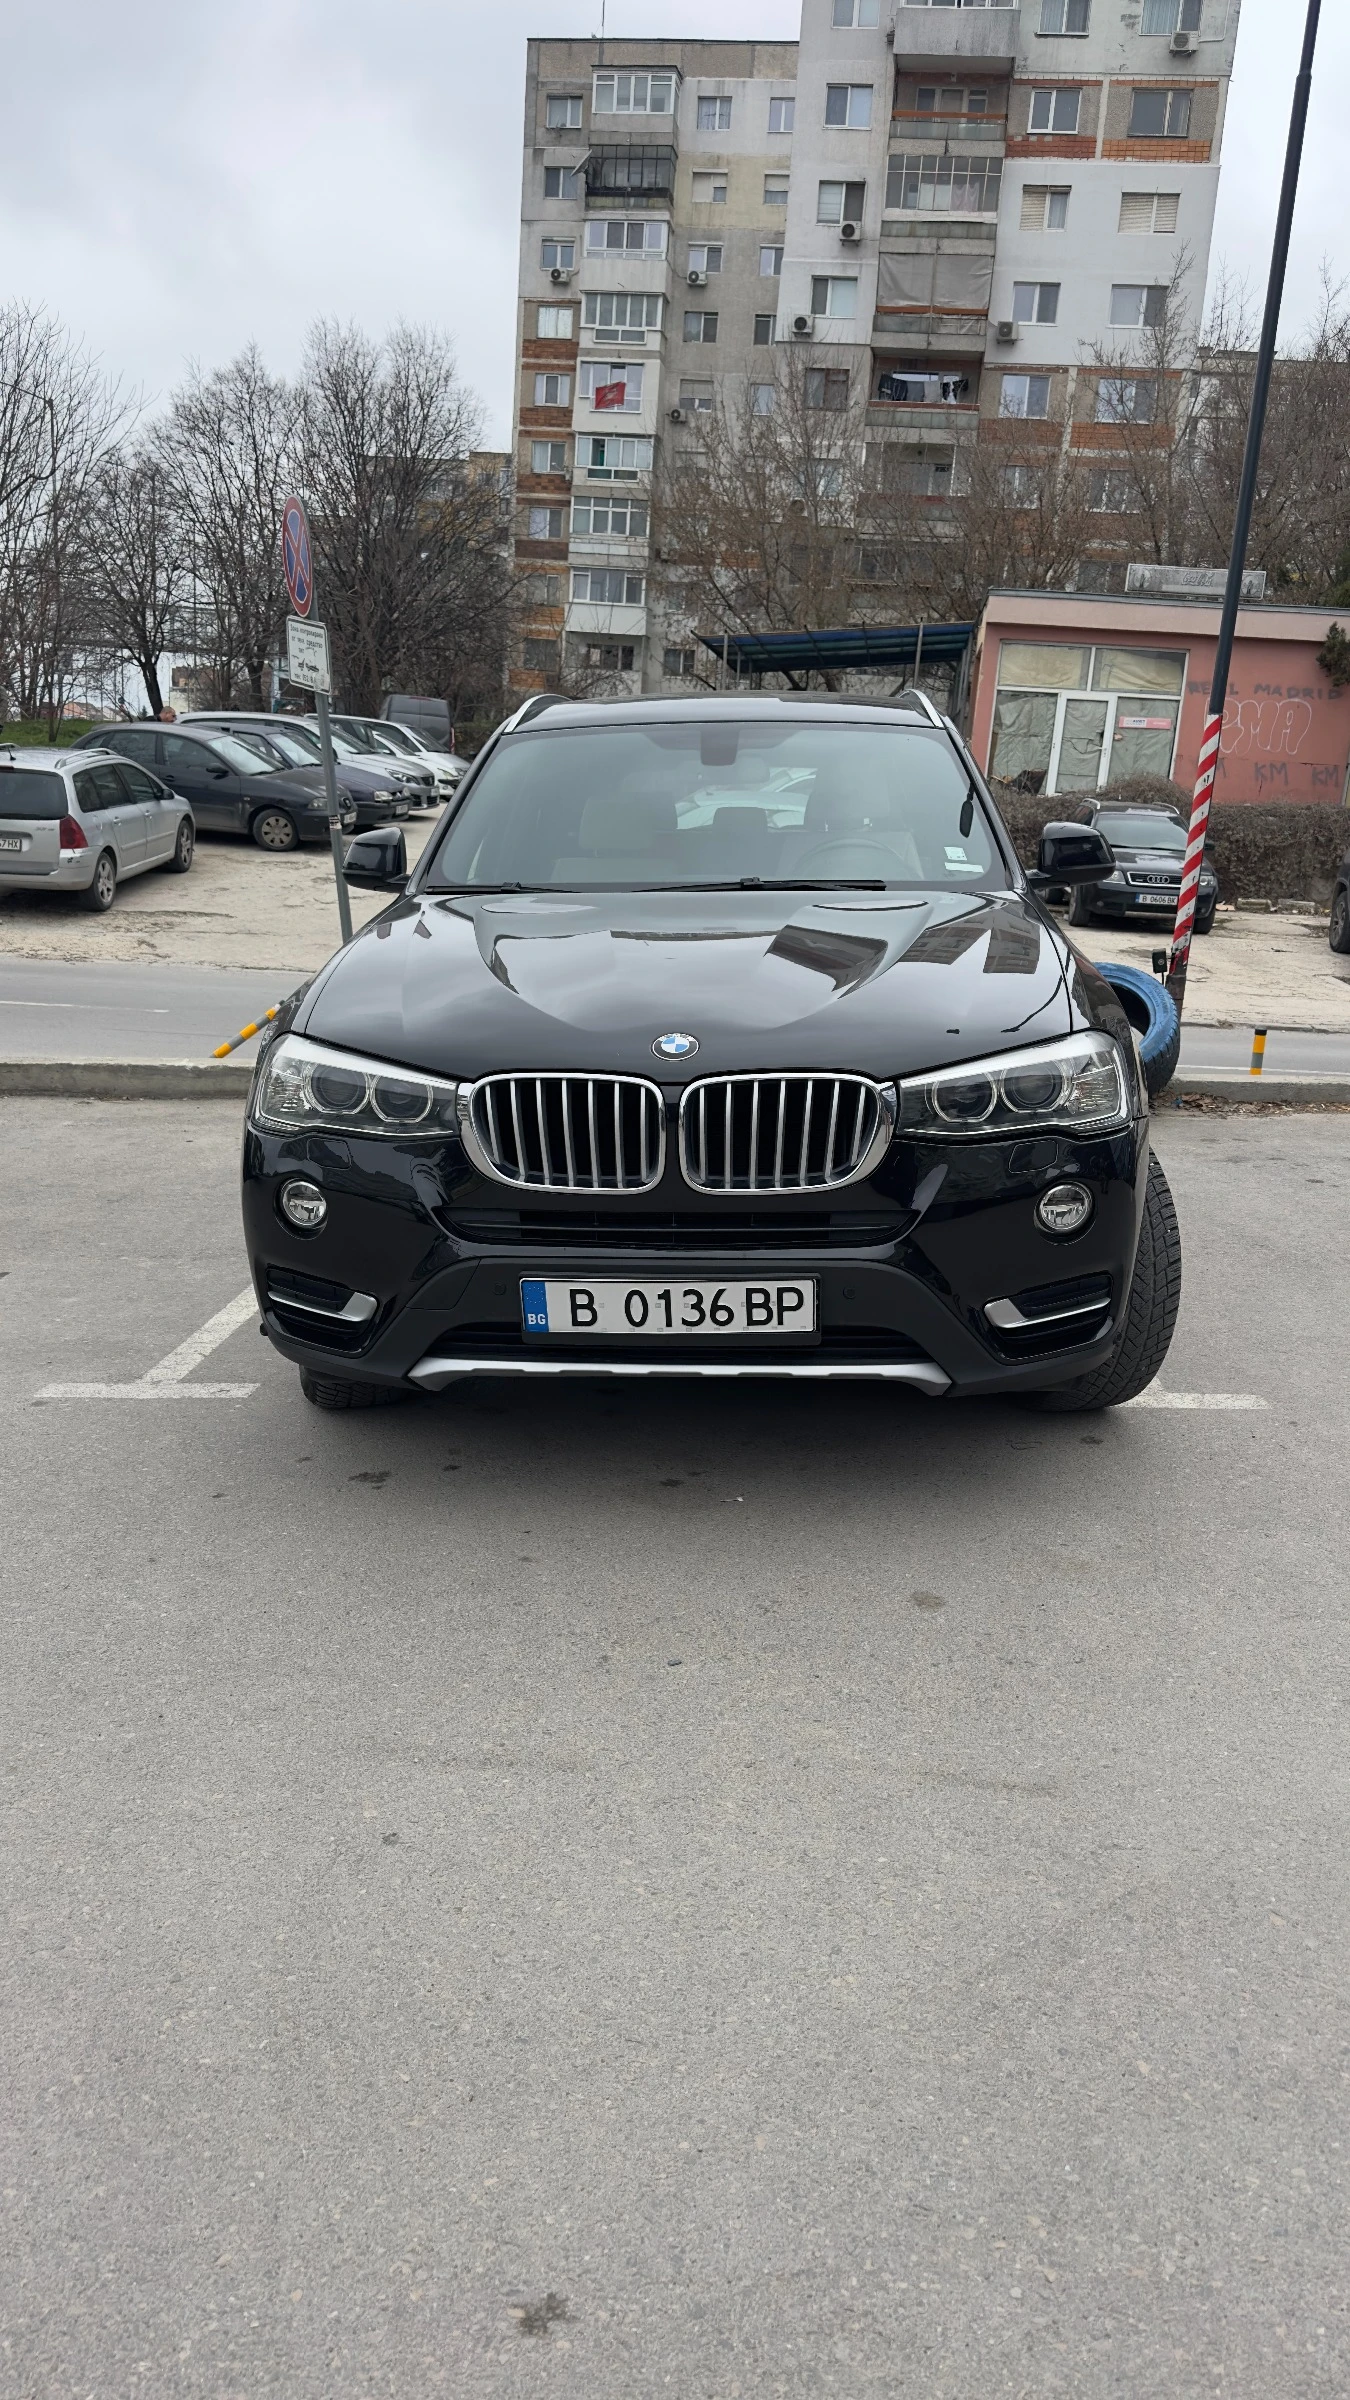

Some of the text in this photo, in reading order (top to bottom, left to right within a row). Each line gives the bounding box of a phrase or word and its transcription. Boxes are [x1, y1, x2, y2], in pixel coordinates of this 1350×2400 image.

[1187, 681, 1343, 700] REL MADRID
[1254, 761, 1289, 785] KM
[1311, 766, 1339, 788] KM
[527, 1313, 546, 1325] BG
